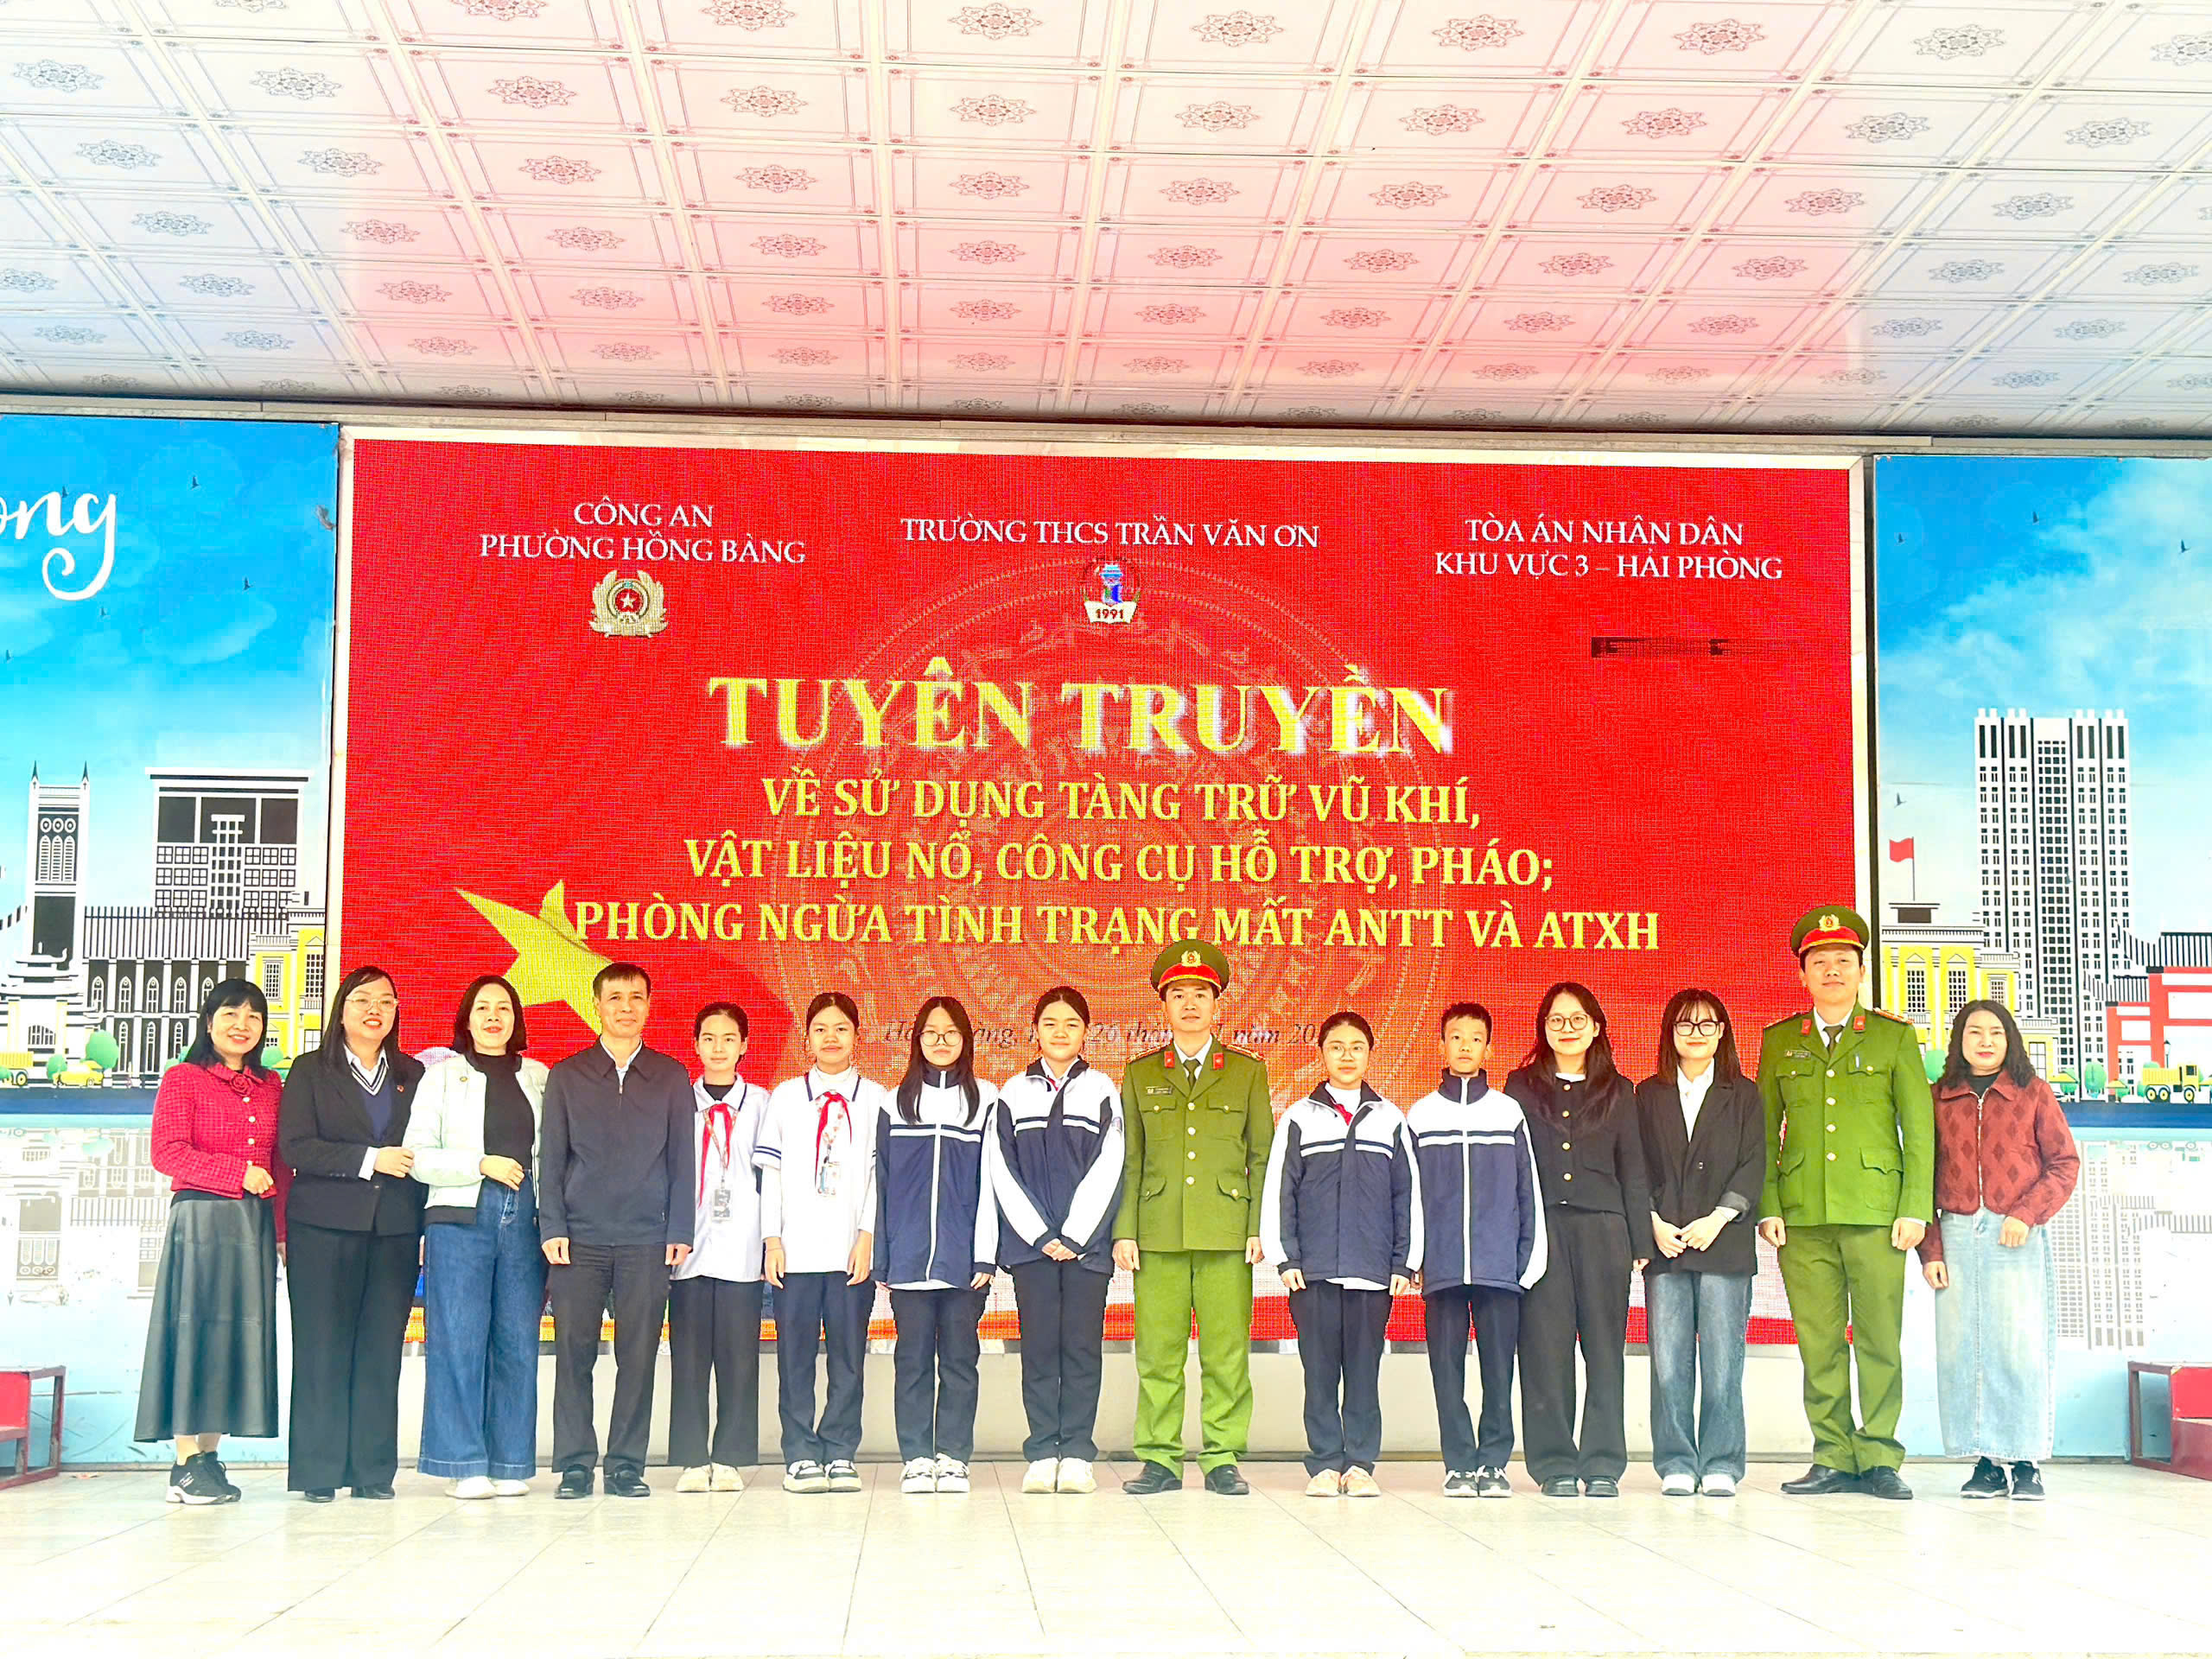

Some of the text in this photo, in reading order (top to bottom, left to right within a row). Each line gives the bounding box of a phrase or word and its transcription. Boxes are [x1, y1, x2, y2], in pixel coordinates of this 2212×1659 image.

[574, 495, 714, 528] CÔNG AN
[1465, 512, 1744, 546] TÒA ÁN NHÂN DÂN
[480, 529, 806, 565] PHƯỜNG HỒNG BÀNG
[900, 512, 1319, 549] TRƯỜNG THCS TRẦN VĂN ƠN
[1434, 552, 1499, 575] KHU
[1506, 549, 1568, 580] VỰC
[1574, 554, 1589, 576] 3
[1617, 548, 1669, 578] HẢI
[1677, 549, 1783, 580] PHÒNG
[1096, 608, 1123, 620] 1991
[708, 656, 1453, 758] TUYÊN TRUYỀN
[761, 766, 1481, 830] VỀ SỬ DỤNG TÀNG TRỮ VŨ KHÍ,
[683, 828, 1554, 894] VẬT LIỆU NỔ, CÔNG CỤ HỖ TRỢ, PHÁO;
[575, 893, 1660, 955] PHÒNG NGỪA TÌNH TRẠNG MẤT ANTT VÀ ATXH
